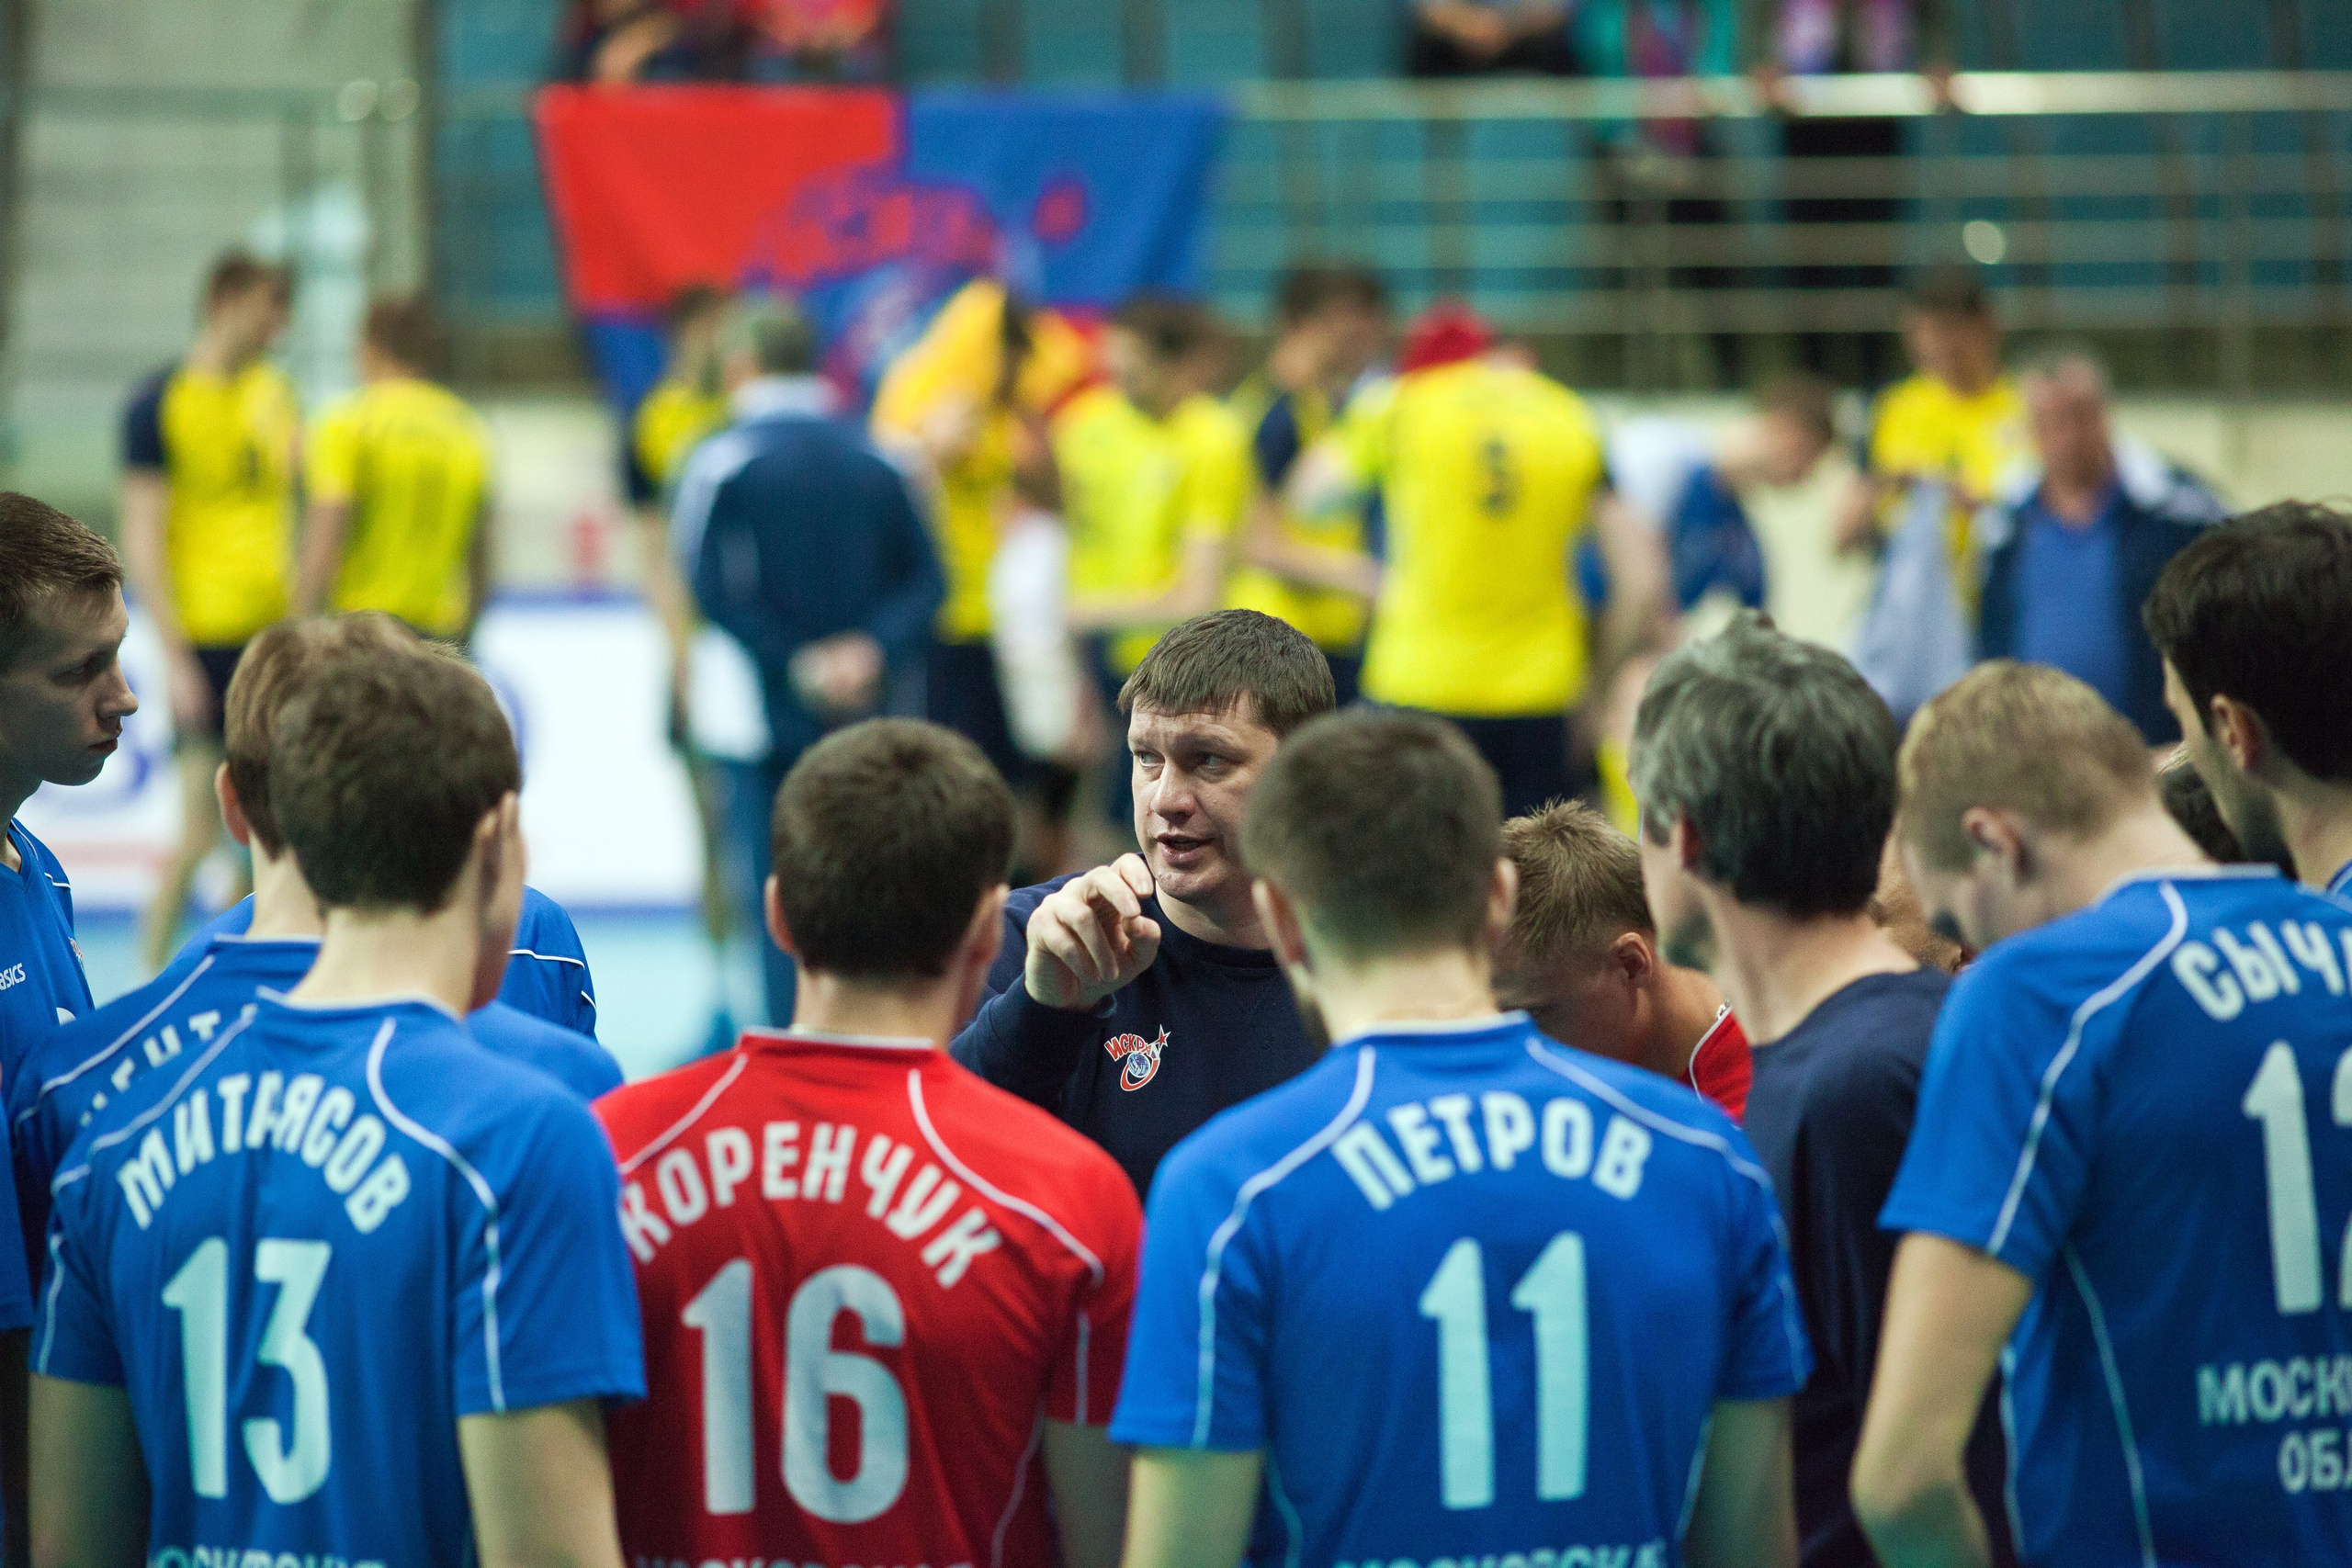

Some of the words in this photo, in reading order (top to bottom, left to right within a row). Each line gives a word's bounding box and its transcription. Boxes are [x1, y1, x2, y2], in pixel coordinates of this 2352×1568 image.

[2171, 919, 2352, 1022] СЫЧ
[618, 1121, 1001, 1288] КОРЕНЧУК
[1333, 1091, 1652, 1210] ПЕТРОВ
[2242, 1039, 2352, 1315] 1
[161, 1236, 332, 1504] 13
[683, 1258, 910, 1522] 16
[1419, 1232, 1589, 1509] 11
[2278, 1427, 2352, 1494] ОБ
